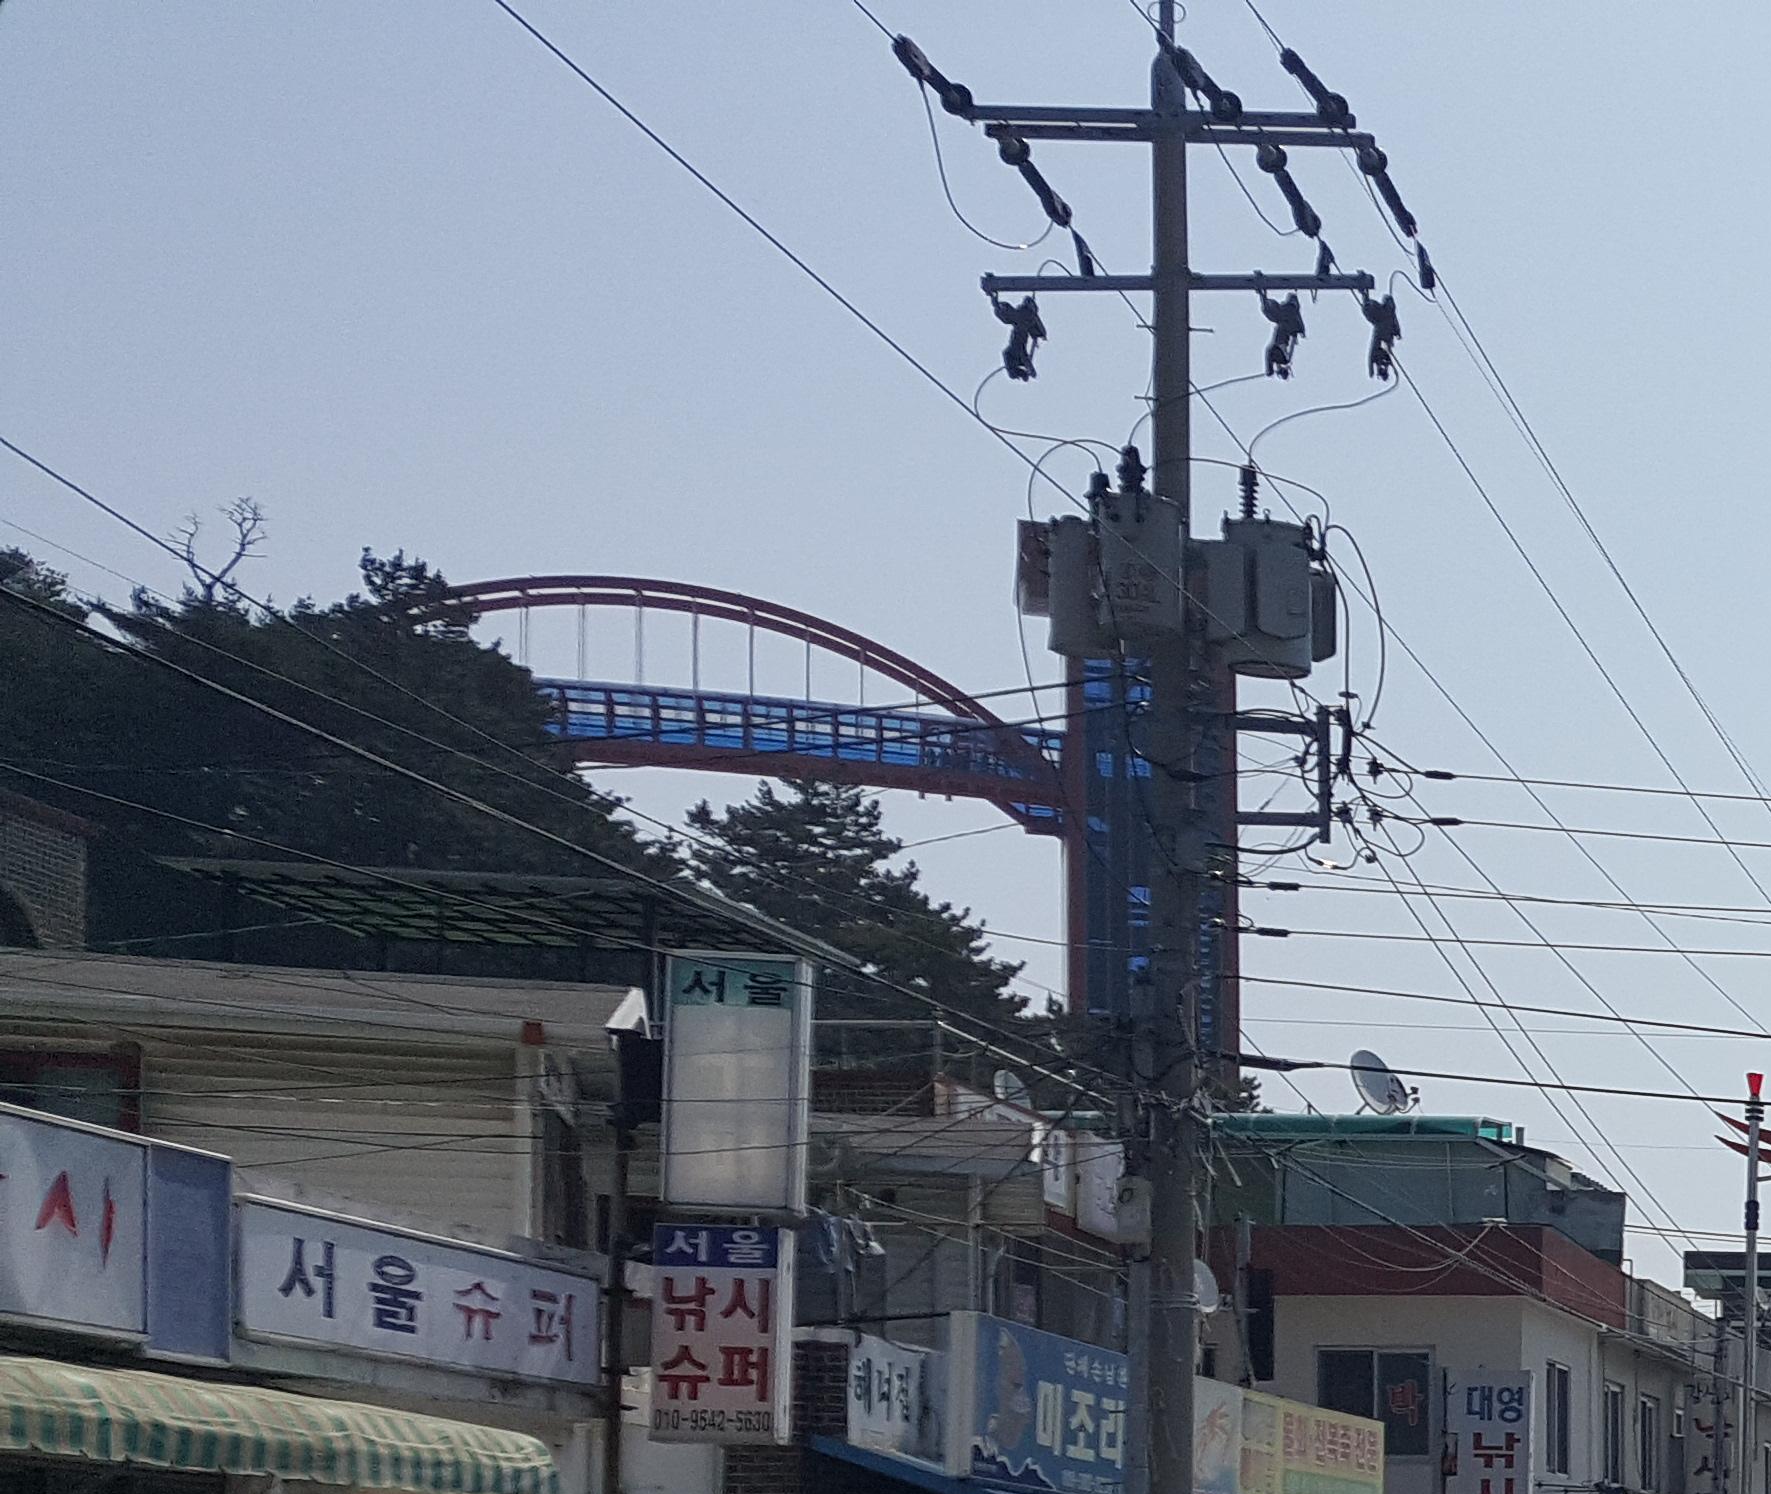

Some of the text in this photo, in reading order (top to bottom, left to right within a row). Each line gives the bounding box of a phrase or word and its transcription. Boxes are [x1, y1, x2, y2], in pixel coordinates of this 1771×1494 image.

[681, 969, 788, 1006] 서울
[0, 1168, 118, 1271] 시
[664, 1229, 771, 1264] 서울
[661, 1275, 771, 1334] 낚시
[656, 1344, 770, 1403] 슈퍼
[1466, 1385, 1525, 1424] 대영
